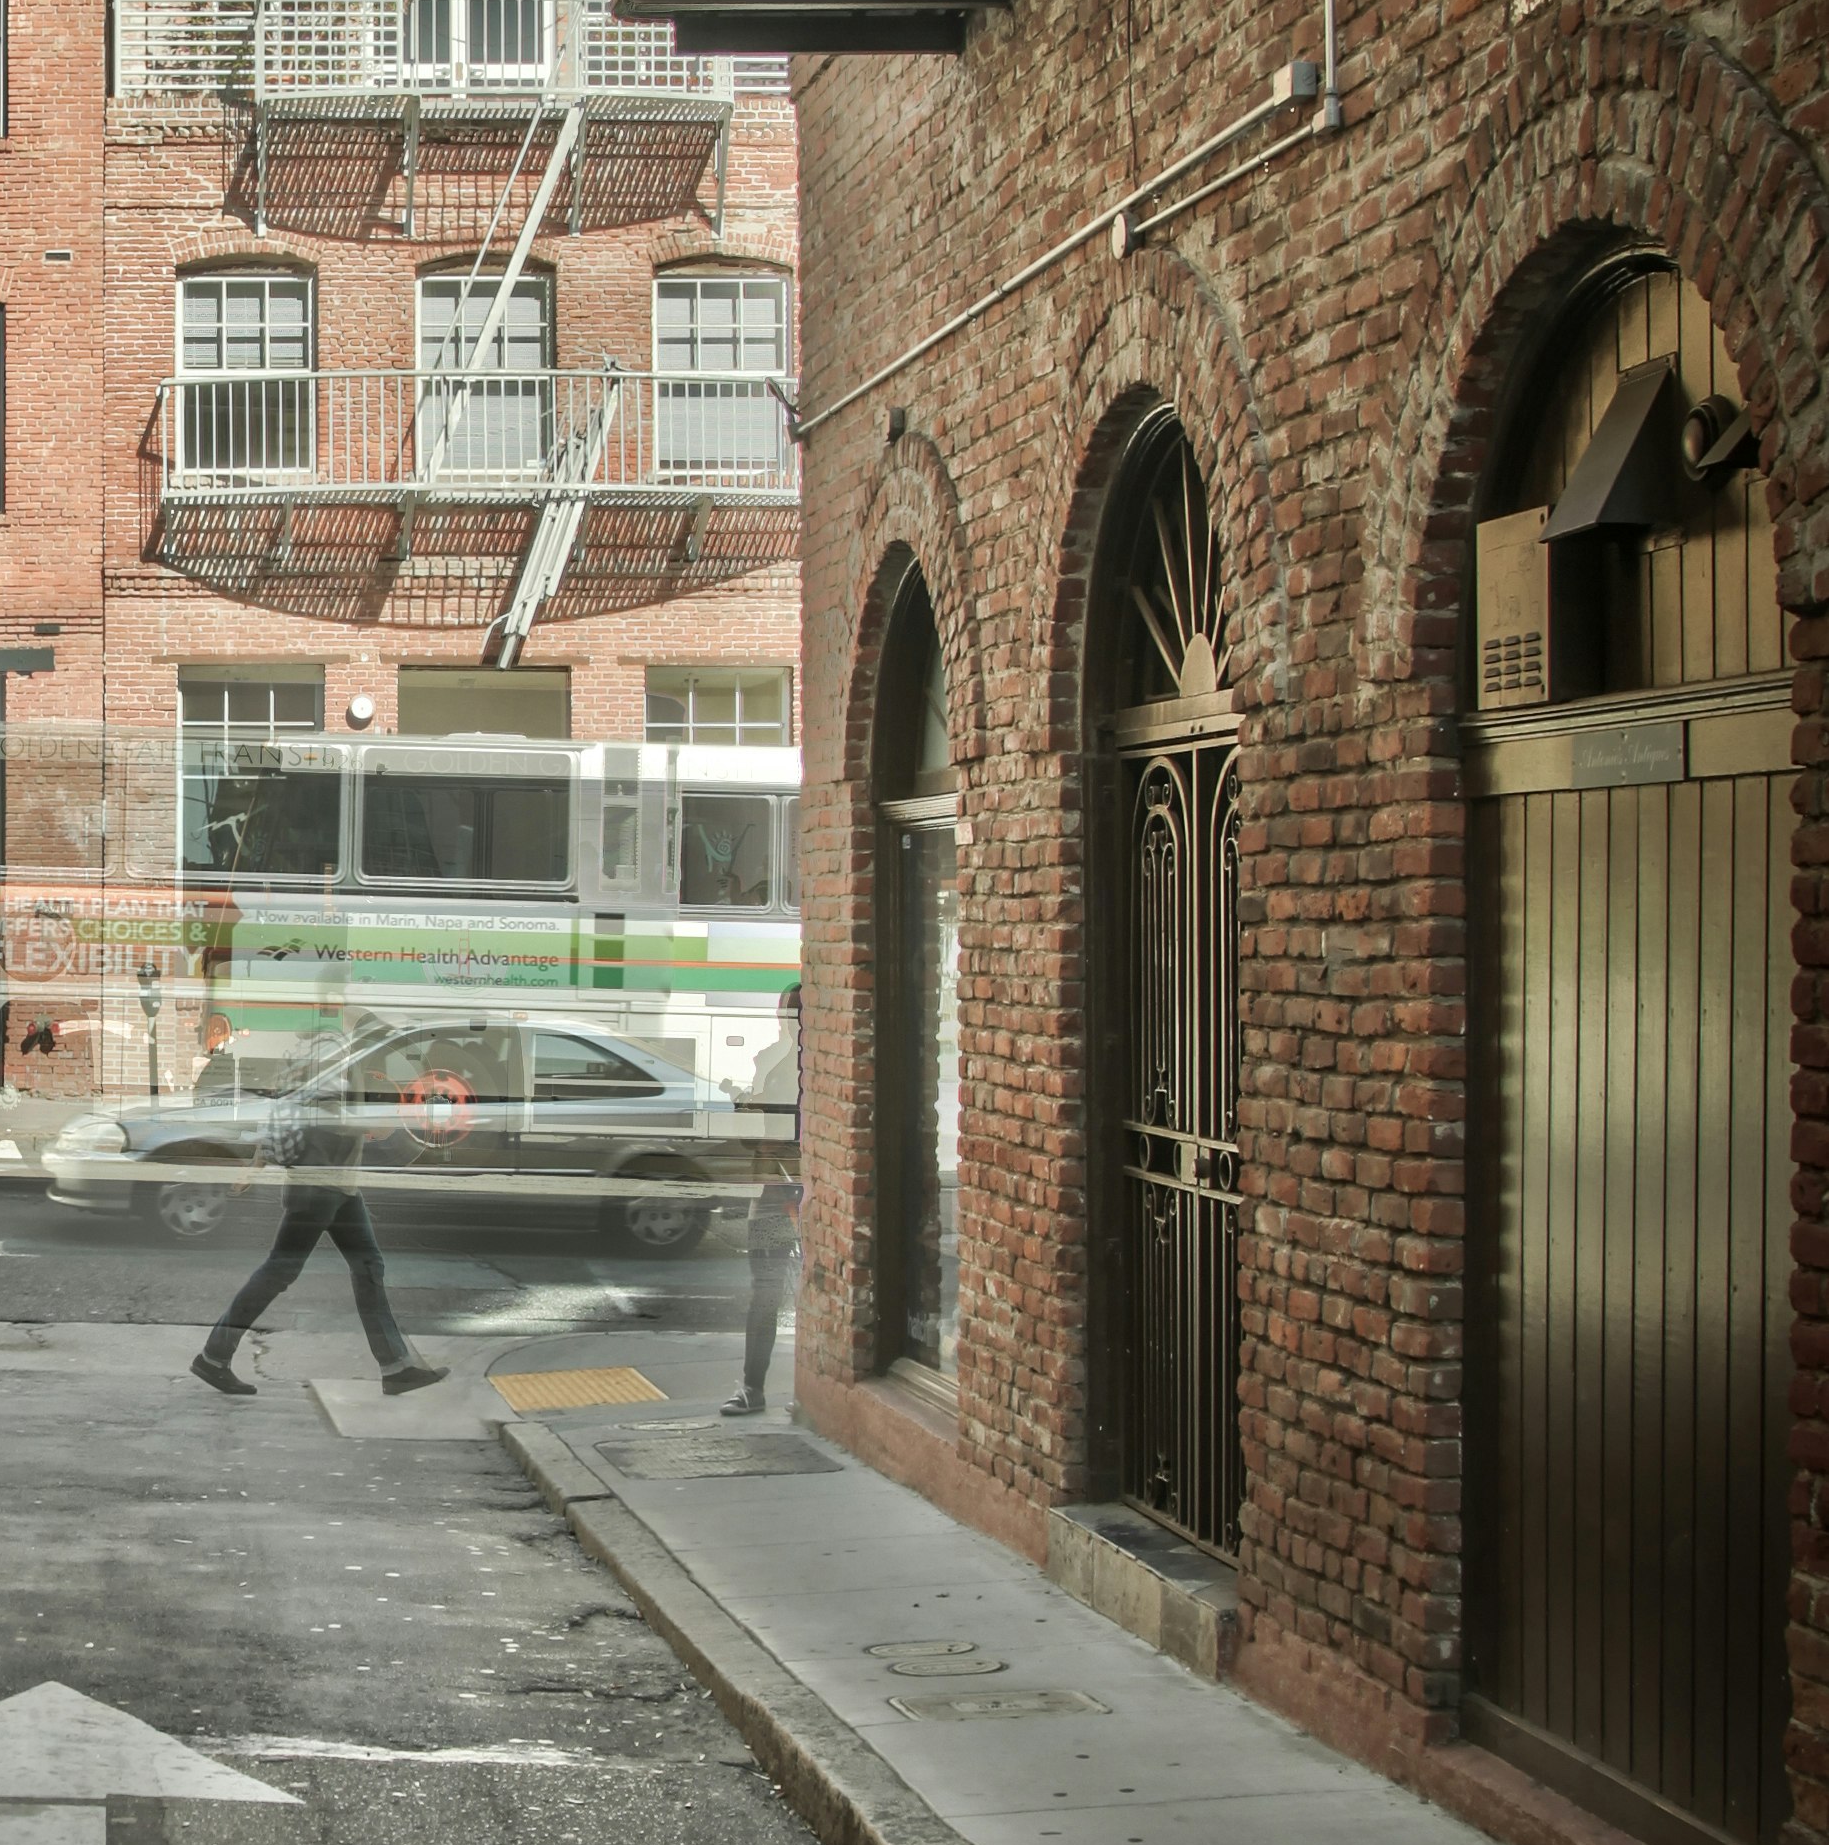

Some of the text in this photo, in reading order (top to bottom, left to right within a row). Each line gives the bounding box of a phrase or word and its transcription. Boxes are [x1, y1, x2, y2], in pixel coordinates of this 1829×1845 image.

[199, 742, 331, 767] TRANSIT
[403, 751, 528, 775] GOLDEN
[4, 897, 84, 914] HEALTH
[90, 898, 147, 916] PLAN
[152, 900, 209, 918] THAT
[78, 919, 183, 942] CHOICES
[189, 922, 207, 942] &
[256, 910, 560, 931] Now available in Marin, Napa and Sonoma.
[314, 944, 559, 972] Western Health Advantage
[434, 974, 559, 987] westernhealth.com
